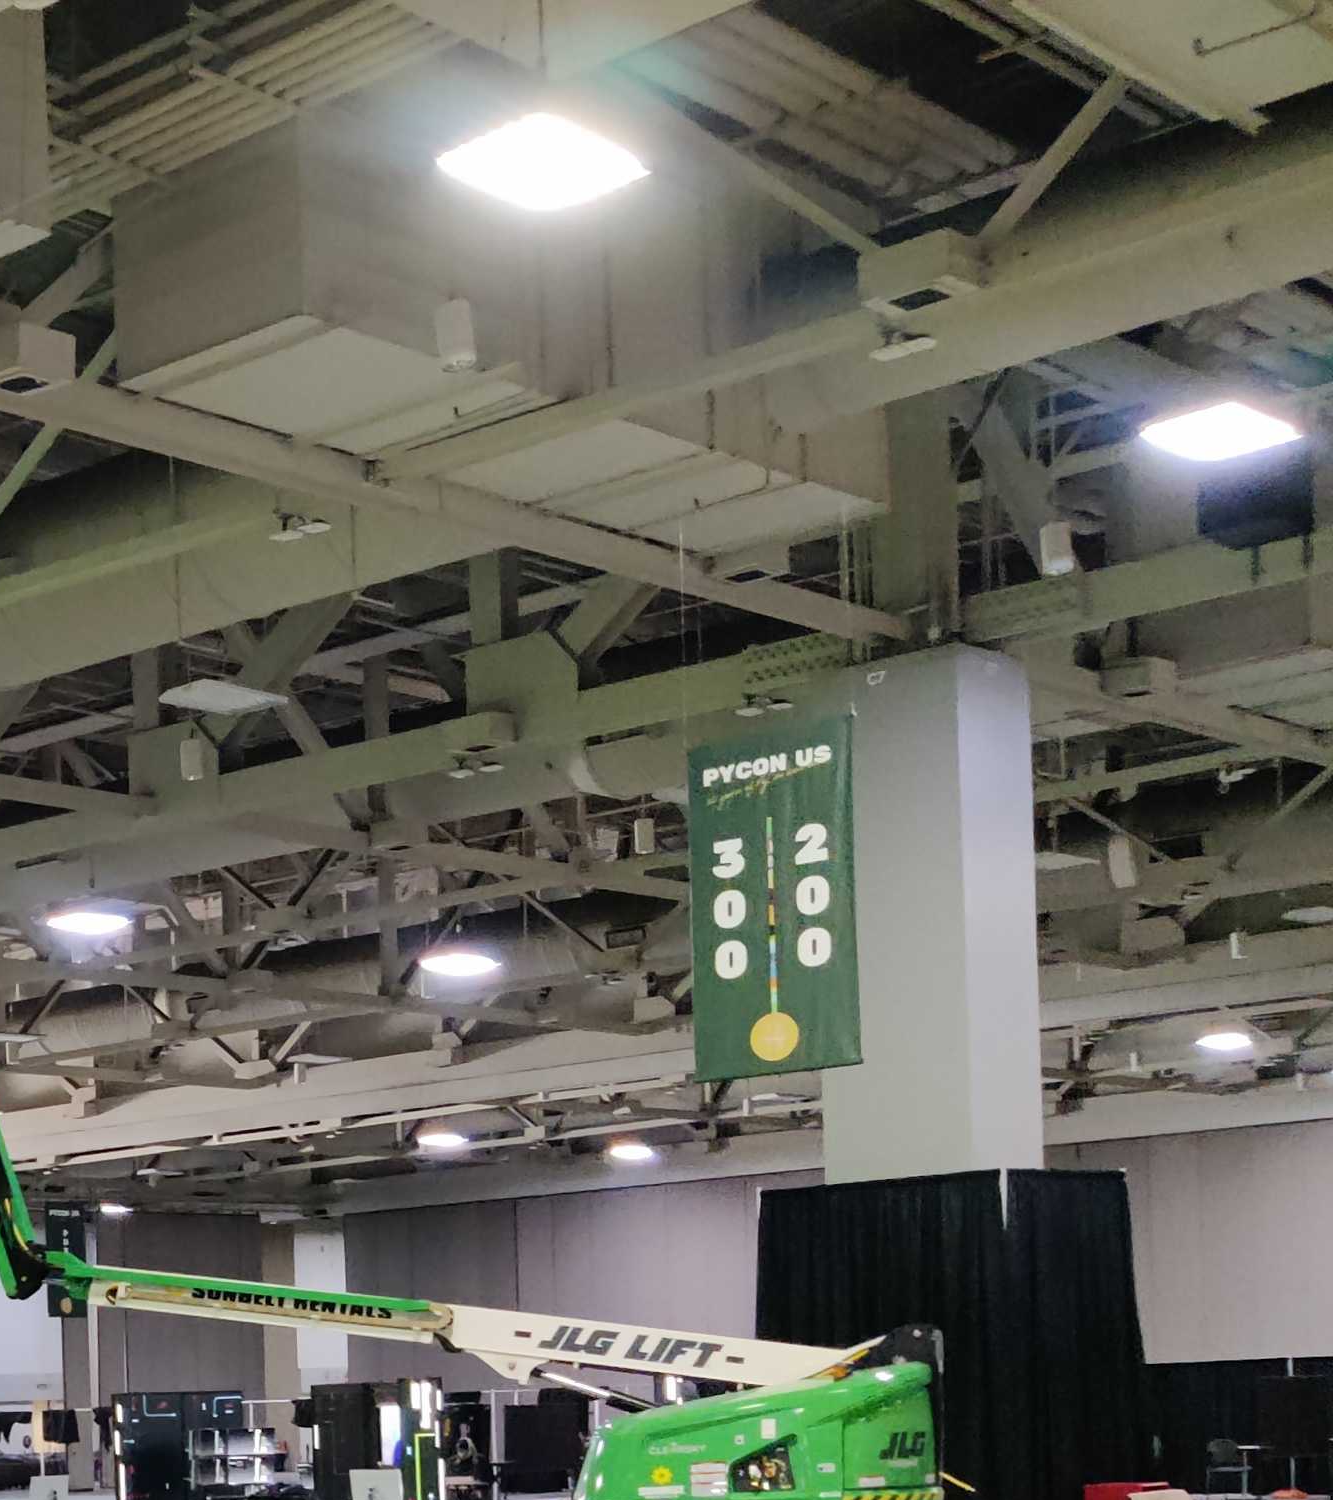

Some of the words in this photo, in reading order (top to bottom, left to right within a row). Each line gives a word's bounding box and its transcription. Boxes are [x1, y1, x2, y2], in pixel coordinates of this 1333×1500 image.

[702, 752, 788, 788] PYCON
[794, 744, 833, 768] US
[538, 1325, 620, 1356] JLG
[624, 1334, 724, 1368] LIFT
[879, 1431, 927, 1460] JLG
